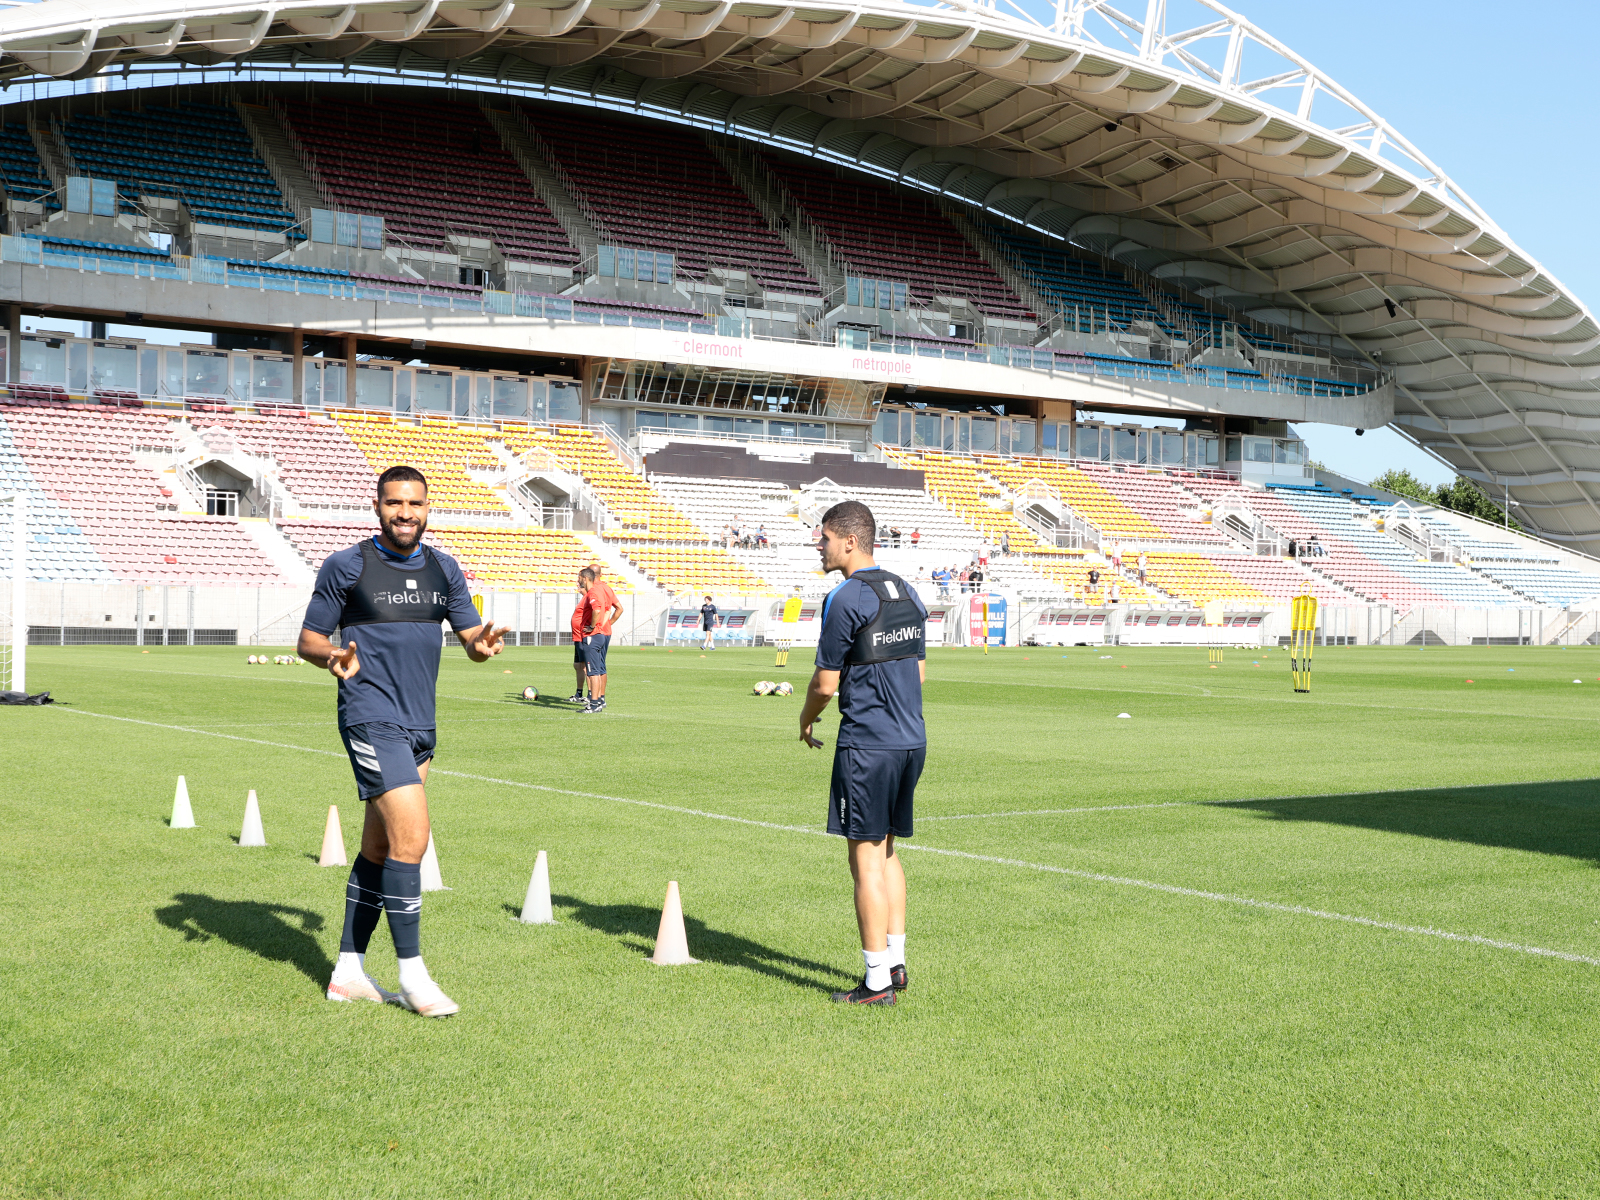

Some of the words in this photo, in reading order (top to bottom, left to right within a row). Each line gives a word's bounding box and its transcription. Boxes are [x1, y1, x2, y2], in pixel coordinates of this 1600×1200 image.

[683, 339, 743, 358] clermont
[852, 356, 912, 376] métropole
[987, 612, 1005, 620] VILLE
[988, 621, 1004, 629] SPORT
[872, 626, 921, 647] FieldWiz
